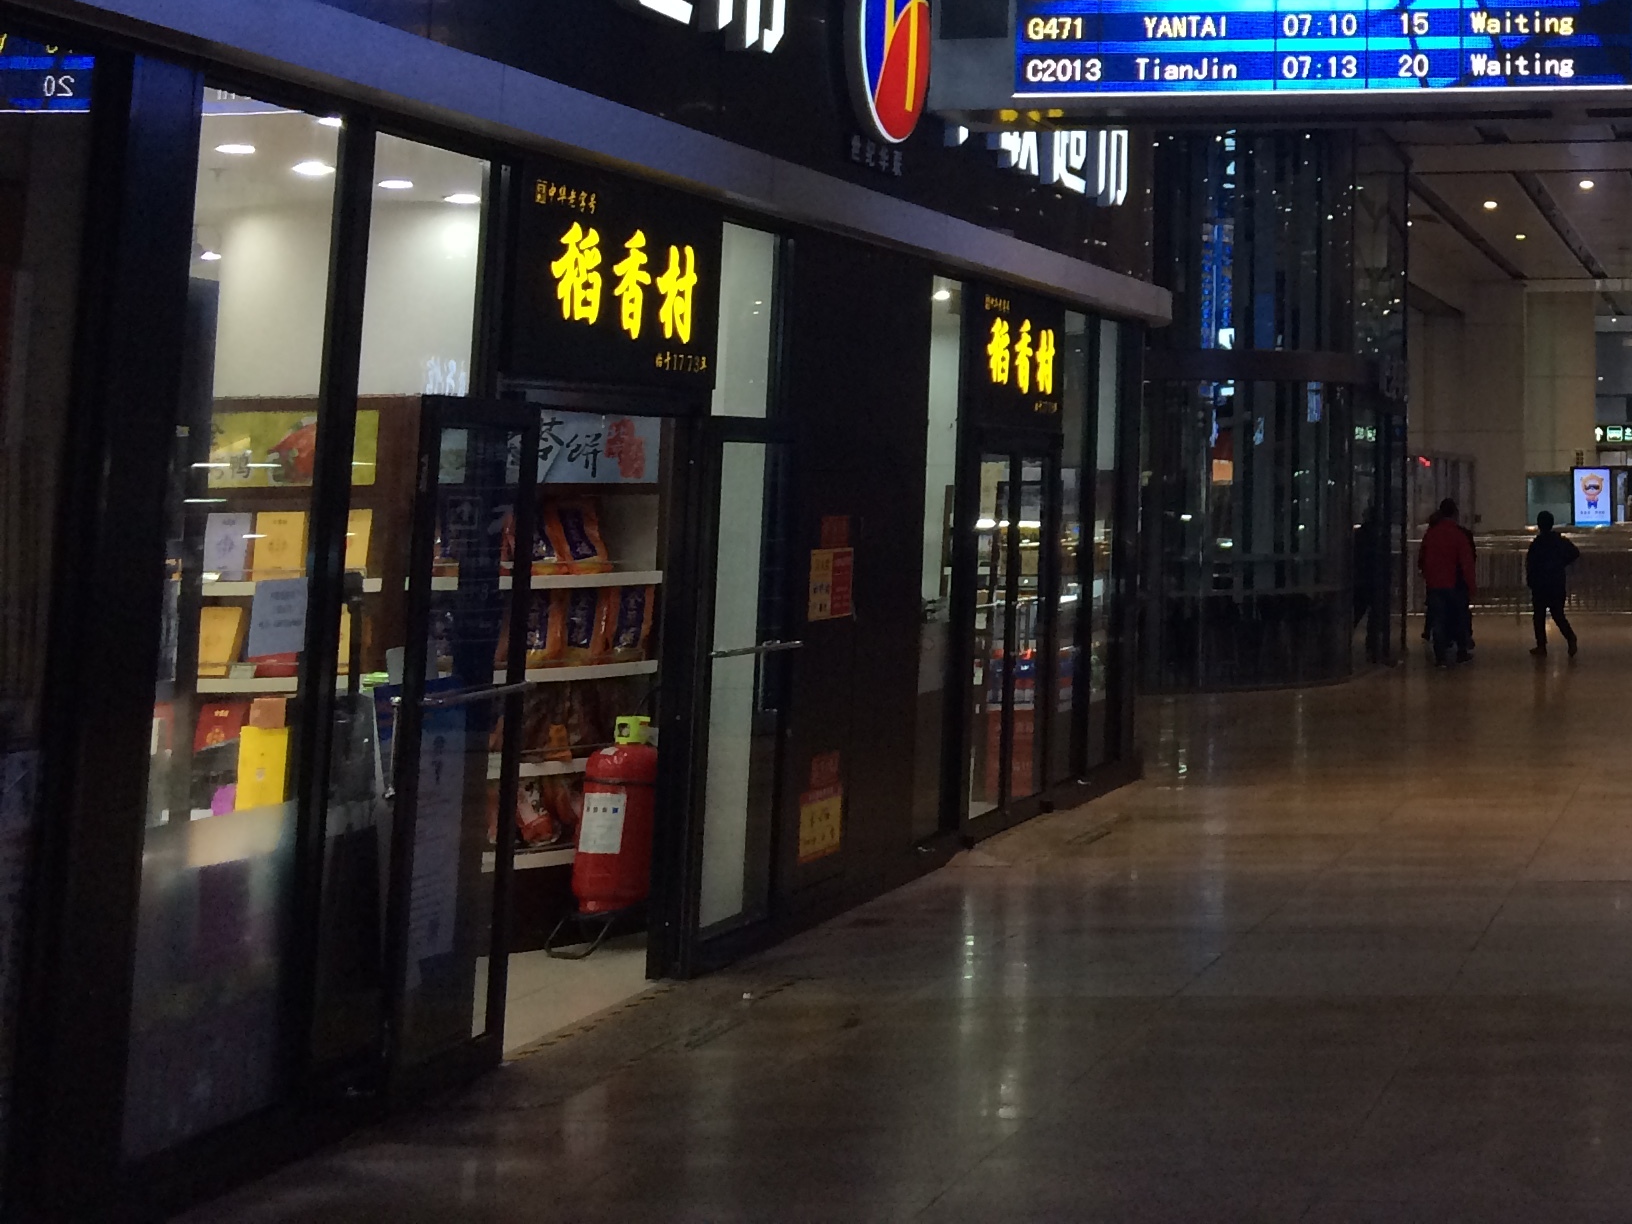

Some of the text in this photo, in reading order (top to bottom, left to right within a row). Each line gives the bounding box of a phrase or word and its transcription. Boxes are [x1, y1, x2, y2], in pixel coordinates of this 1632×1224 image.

[1028, 13, 1573, 40] G471 YANTAI 07:10 15 Waiting
[1026, 56, 1574, 82] C2013 TianJin 07:13 20 Waiting
[550, 221, 698, 344] 稻香村
[986, 316, 1056, 395] 稻香村
